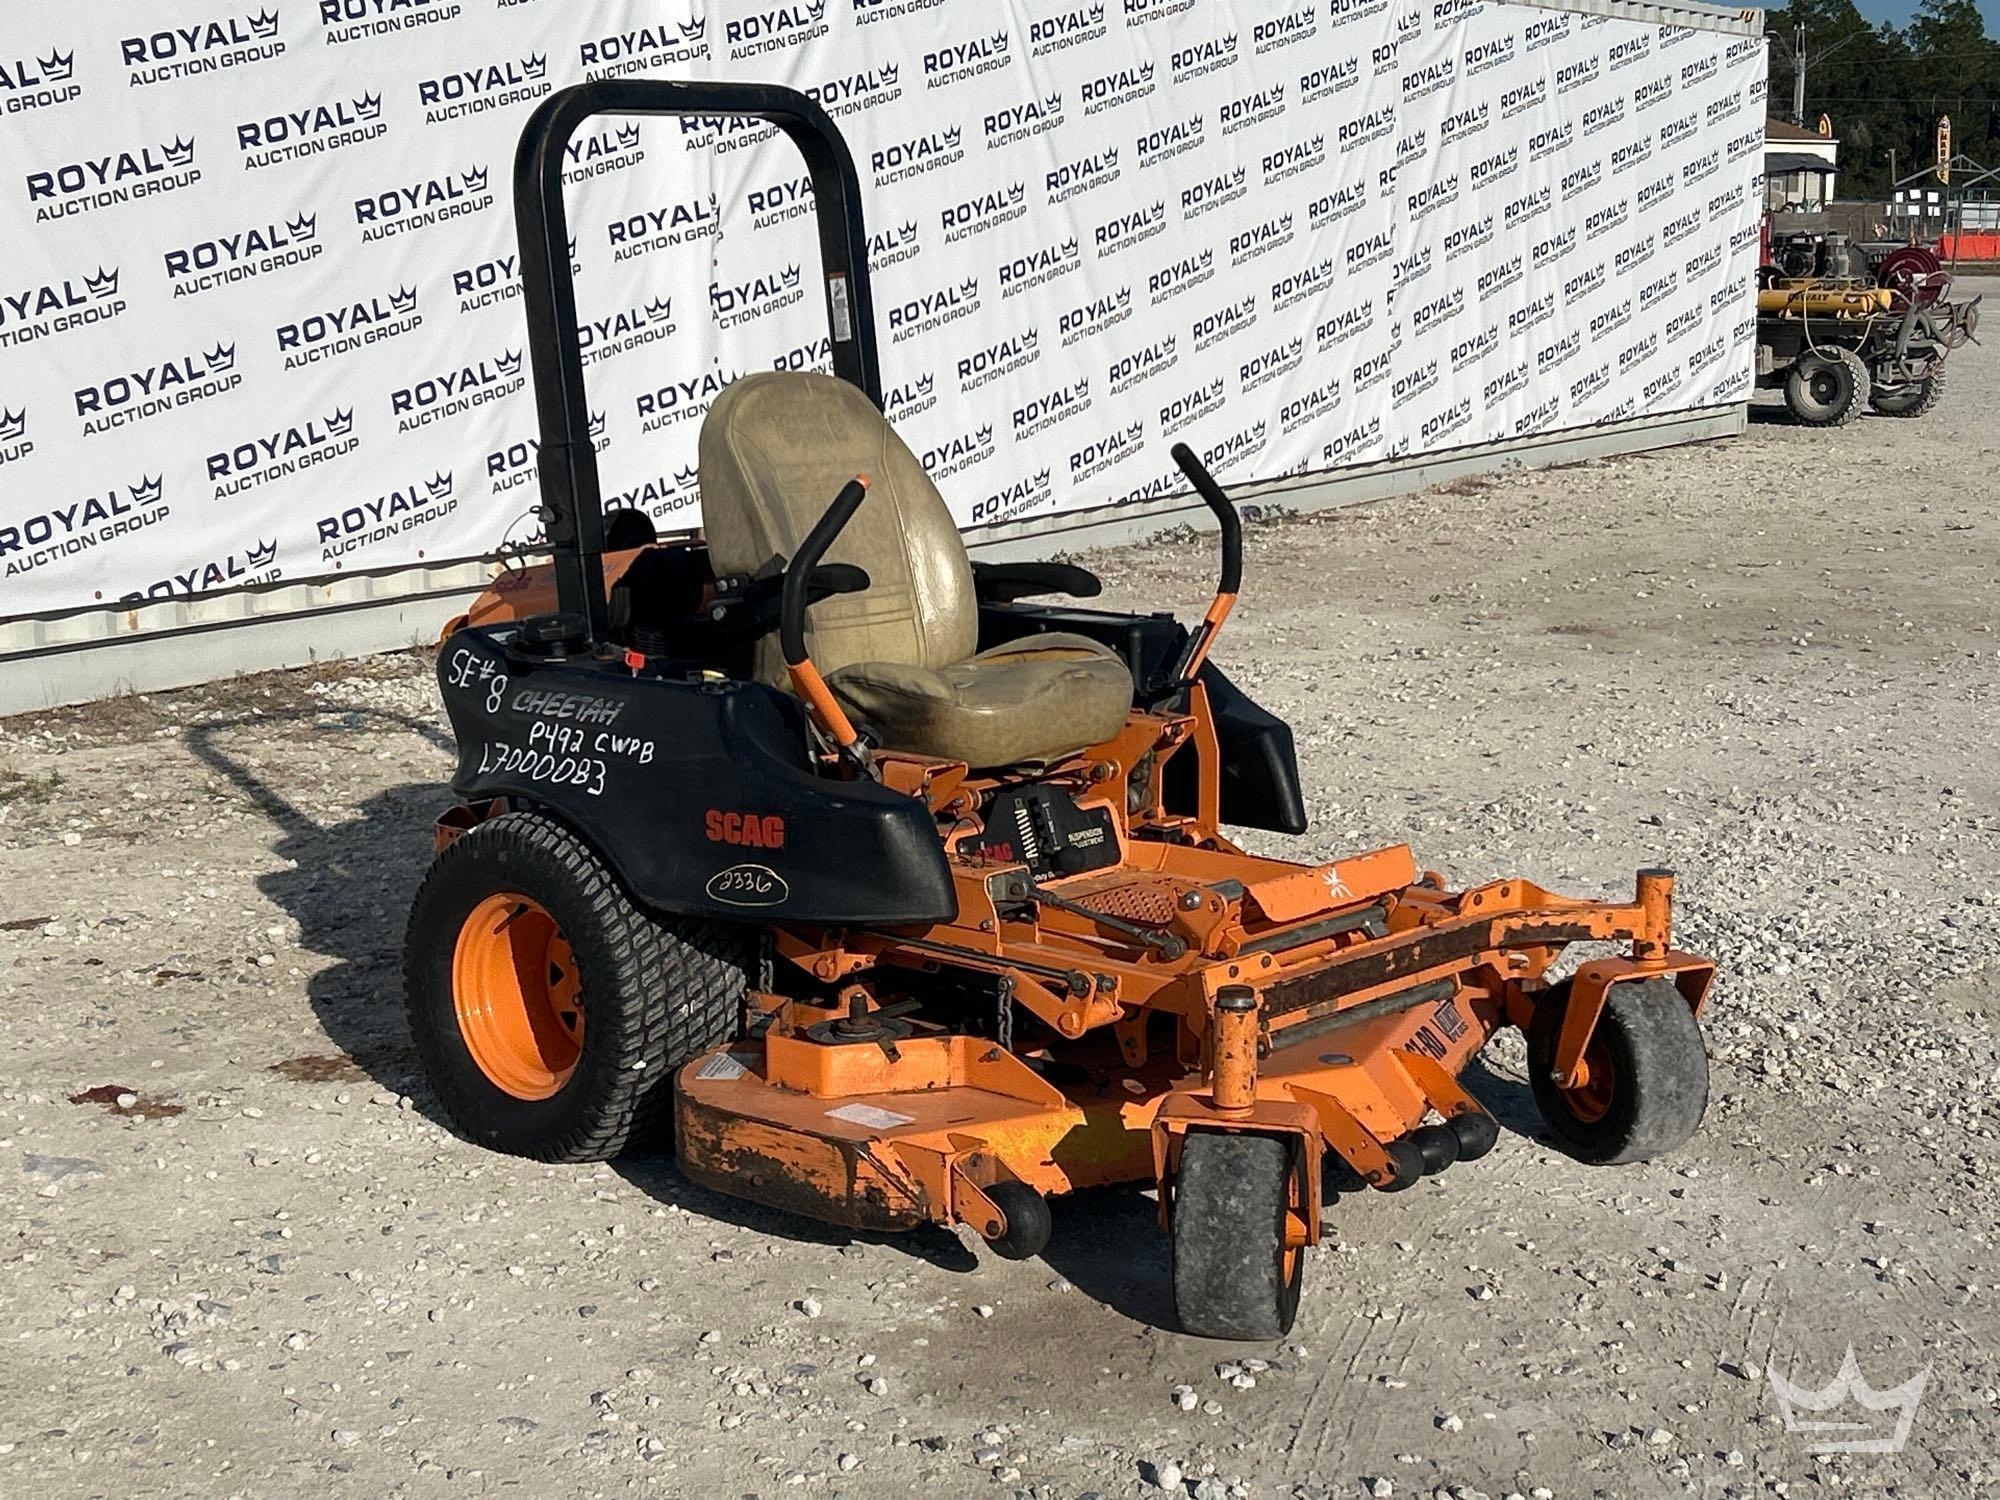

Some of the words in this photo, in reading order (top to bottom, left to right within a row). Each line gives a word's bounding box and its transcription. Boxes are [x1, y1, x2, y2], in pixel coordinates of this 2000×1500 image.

[120, 18, 250, 66] ROYAL
[325, 18, 401, 46] AUCTION
[403, 5, 462, 30] GROUP
[726, 6, 801, 44] ROYAL
[730, 36, 786, 61] AUCTION
[787, 24, 829, 46] GROUP
[1030, 9, 1090, 43] ROYAL
[1032, 36, 1074, 58] AUCTION
[1074, 25, 1107, 45] GROUP
[1253, 12, 1303, 43] ROYAL
[1525, 17, 1560, 42] ROYAL
[129, 56, 218, 87] AUCTION
[220, 42, 286, 68] GROUP
[580, 26, 679, 66] ROYAL
[585, 57, 648, 84] AUCTION
[650, 44, 709, 68] GROUP
[923, 38, 993, 74] ROYAL
[1171, 39, 1224, 72] ROYAL
[1465, 39, 1504, 66] ROYAL
[1609, 37, 1640, 62] ROYAL
[418, 62, 523, 106] ROYAL
[927, 66, 975, 90] AUCTION
[975, 55, 1011, 75] GROUP
[1081, 68, 1140, 103] ROYAL
[1173, 64, 1209, 85] AUCTION
[1210, 53, 1238, 72] GROUP
[1402, 64, 1442, 93] ROYAL
[1556, 60, 1590, 85] ROYAL
[1681, 58, 1709, 81] ROYAL
[7, 85, 82, 114] GROUP
[426, 96, 496, 125] AUCTION
[498, 82, 552, 106] GROUP
[984, 100, 1047, 136] ROYAL
[1084, 95, 1125, 116] AUCTION
[1125, 83, 1156, 103] GROUP
[1220, 91, 1271, 123] ROYAL
[1582, 102, 1615, 127] ROYAL
[237, 102, 355, 151] ROYAL
[987, 127, 1031, 151] AUCTION
[1032, 115, 1065, 135] GROUP
[1137, 122, 1190, 156] ROYAL
[1529, 126, 1564, 152] ROYAL
[1660, 117, 1689, 141] ROYAL
[244, 139, 325, 171] AUCTION
[327, 123, 387, 149] GROUP
[871, 134, 944, 173] ROYAL
[1262, 141, 1312, 174] ROYAL
[26, 148, 165, 202] ROYAL
[874, 163, 925, 189] AUCTION
[926, 149, 964, 171] GROUP
[1470, 152, 1508, 181] ROYAL
[1683, 155, 1712, 179] ROYAL
[36, 187, 129, 223] AUCTION
[132, 169, 202, 198] GROUP
[354, 176, 464, 224] ROYAL
[941, 190, 1008, 230] ROYAL
[1309, 186, 1355, 219] ROYAL
[362, 211, 436, 244] AUCTION
[437, 195, 494, 221] GROUP
[944, 219, 991, 245] AUCTION
[992, 205, 1027, 227] GROUP
[1095, 209, 1152, 246] ROYAL
[1585, 204, 1618, 231] ROYAL
[1663, 214, 1692, 239] ROYAL
[164, 225, 289, 279] ROYAL
[1097, 234, 1137, 259] AUCTION
[1137, 221, 1167, 242] GROUP
[1615, 240, 1646, 267] ROYAL
[173, 263, 257, 299] AUCTION
[260, 244, 323, 273] GROUP
[999, 246, 1061, 286] ROYAL
[1002, 273, 1046, 300] AUCTION
[1046, 259, 1081, 281] GROUP
[1272, 266, 1320, 301] ROYAL
[889, 287, 961, 329] ROYAL
[1413, 294, 1453, 327] ROYAL
[1710, 282, 1738, 307] ROYAL
[54, 300, 127, 333] GROUP
[276, 298, 391, 352] ROYAL
[892, 315, 941, 344] AUCTION
[942, 300, 981, 324] GROUP
[1193, 303, 1243, 341] ROYAL
[1194, 328, 1229, 354] AUCTION
[1229, 314, 1257, 335] GROUP
[1316, 308, 1361, 342] ROYAL
[1590, 306, 1621, 333] ROYAL
[284, 334, 362, 371] AUCTION
[364, 315, 423, 344] GROUP
[957, 337, 1022, 379] ROYAL
[1450, 331, 1489, 363] ROYAL
[1619, 338, 1650, 366] ROYAL
[961, 365, 1006, 394] AUCTION
[1006, 349, 1040, 373] GROUP
[1240, 345, 1290, 382] ROYAL
[74, 356, 206, 417] ROYAL
[83, 396, 172, 437] AUCTION
[175, 374, 242, 406] GROUP
[391, 362, 497, 416] ROYAL
[398, 397, 470, 434] AUCTION
[471, 376, 525, 406] GROUP
[1013, 387, 1075, 429] ROYAL
[1015, 414, 1057, 443] AUCTION
[1057, 398, 1092, 422] GROUP
[206, 421, 327, 481] ROYAL
[214, 460, 296, 500] AUCTION
[298, 437, 359, 469] GROUP
[1070, 431, 1127, 473] ROYAL
[1073, 457, 1113, 486] AUCTION
[1114, 441, 1145, 464] GROUP
[0, 490, 132, 557] ROYAL
[316, 485, 429, 545] ROYAL
[322, 523, 399, 562] AUCTION
[402, 499, 458, 531] GROUP
[5, 532, 97, 578] AUCTION
[99, 505, 170, 542] GROUP
[512, 690, 625, 725] CHEETAH
[705, 809, 785, 848] SCAG
[719, 871, 772, 893] 2336
